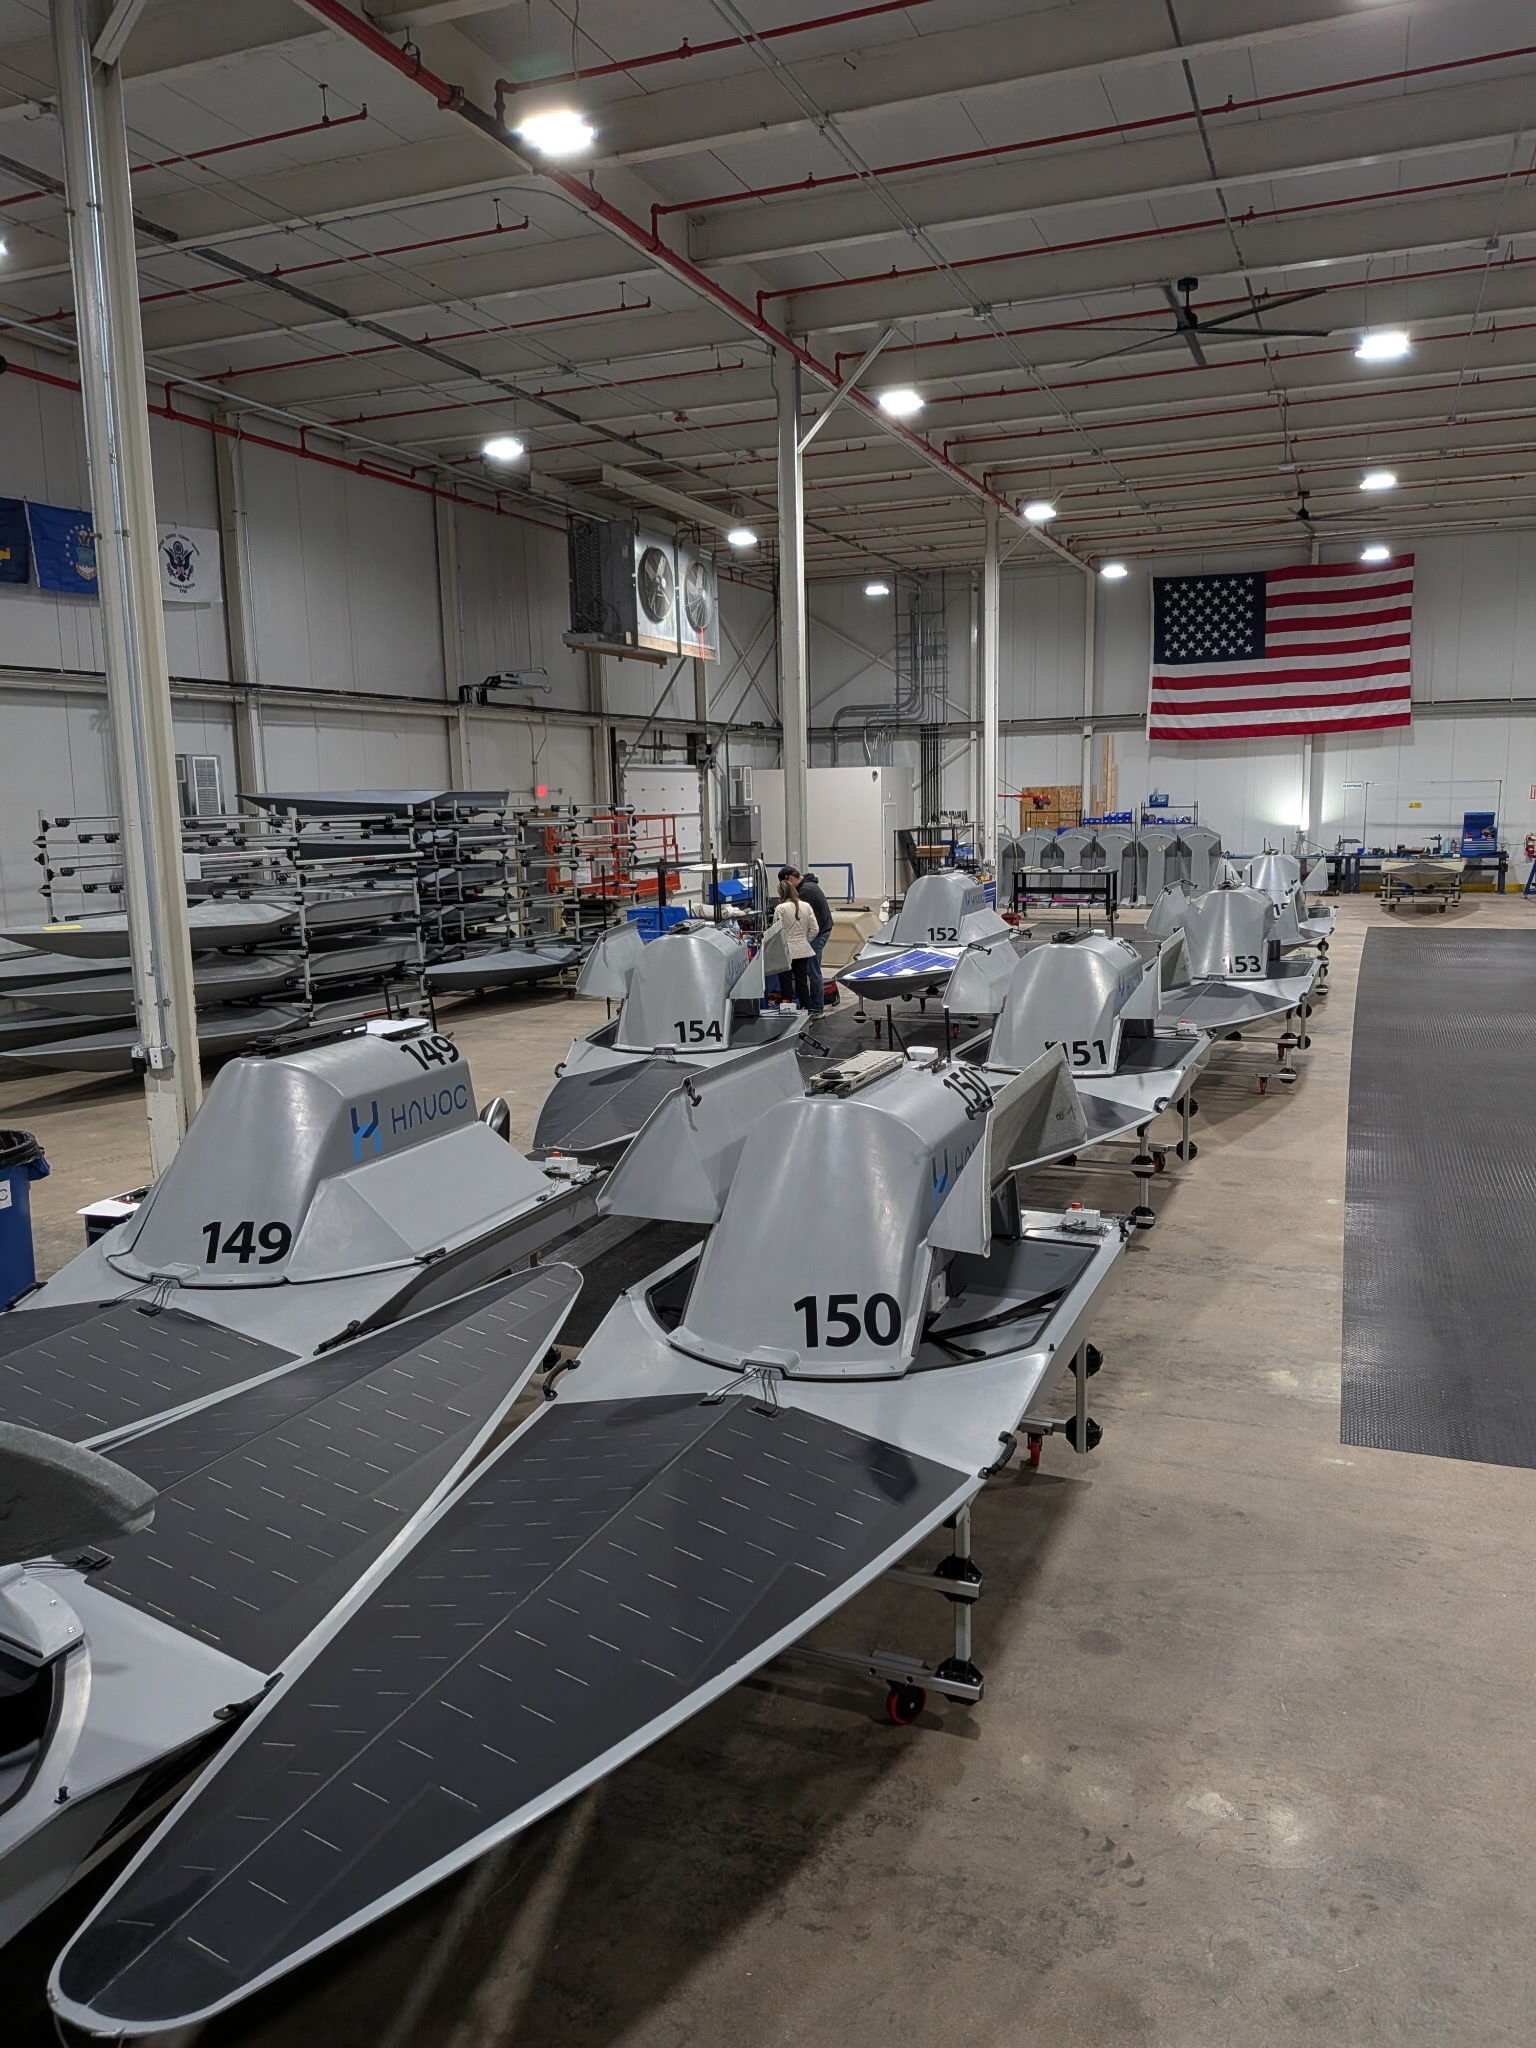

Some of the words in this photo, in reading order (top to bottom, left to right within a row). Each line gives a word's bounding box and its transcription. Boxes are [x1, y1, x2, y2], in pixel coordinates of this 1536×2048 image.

[927, 927, 958, 942] 152
[400, 1035, 459, 1070] 149
[674, 1020, 723, 1043] 154
[391, 1084, 468, 1134] HAVOC
[943, 1067, 991, 1109] 150
[202, 1221, 292, 1264] 149
[793, 1292, 902, 1348] 150
